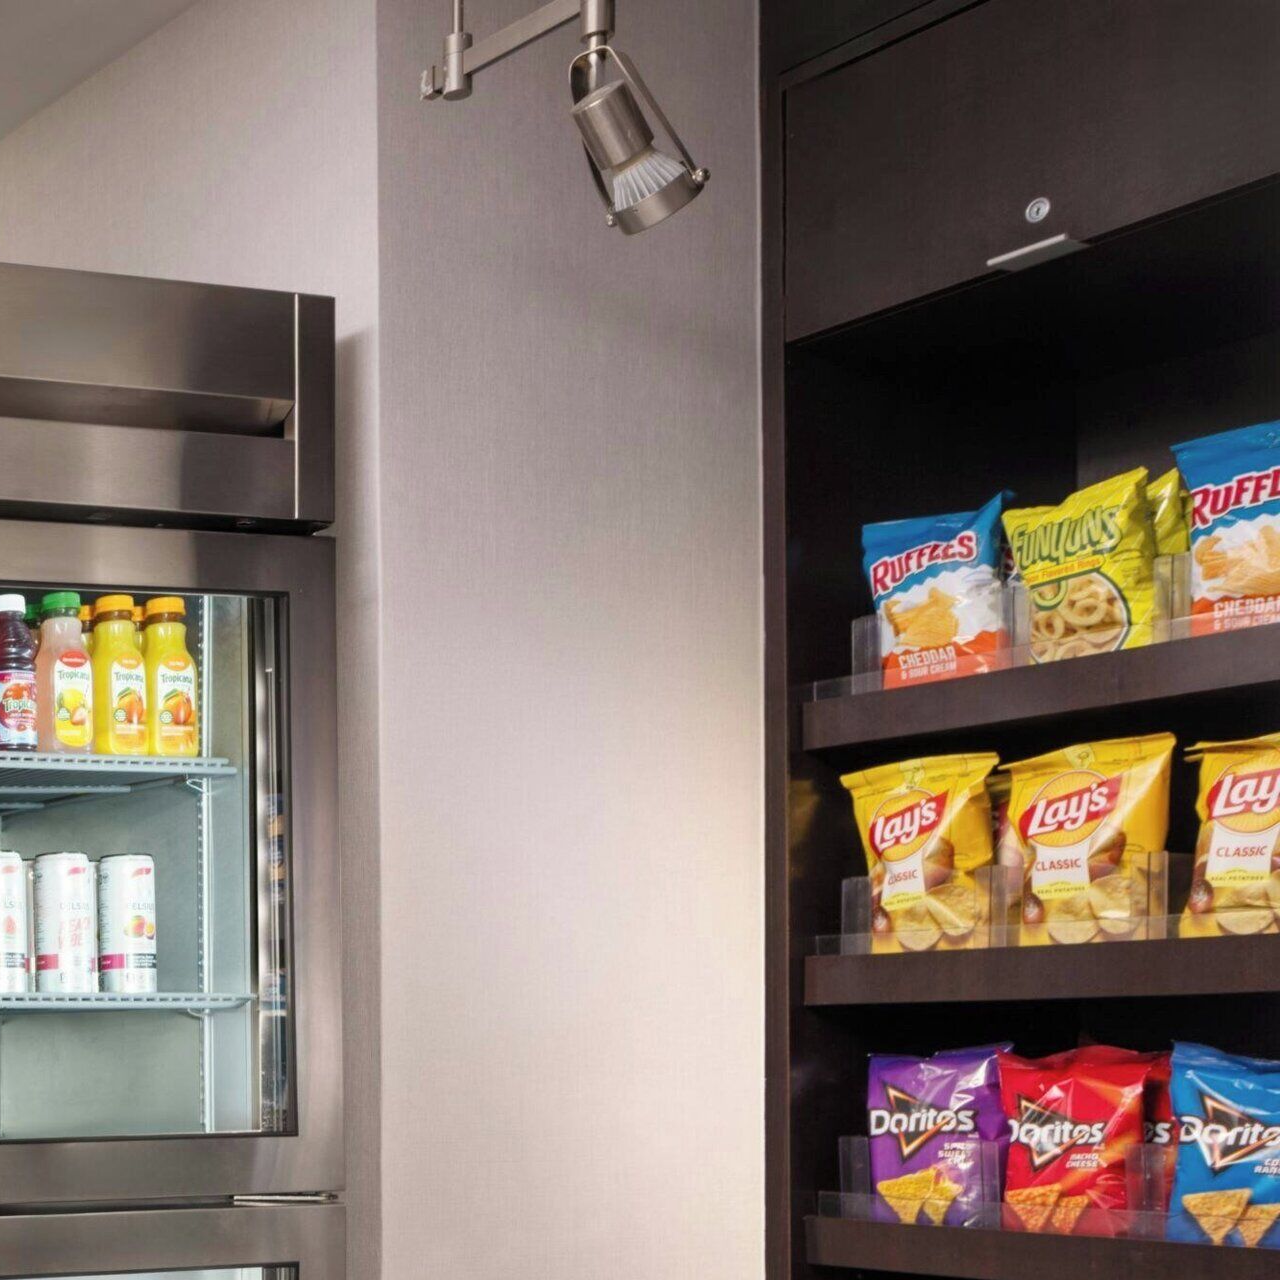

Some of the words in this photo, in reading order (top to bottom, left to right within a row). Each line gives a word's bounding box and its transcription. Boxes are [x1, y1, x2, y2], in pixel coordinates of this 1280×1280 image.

[1012, 504, 1123, 570] FUNYUNS
[871, 530, 978, 597] RUFFLES
[899, 646, 955, 670] CHEDDAR
[58, 670, 90, 682] Tropicana
[114, 671, 144, 683] Tropicana
[162, 673, 193, 685] Tropicana
[1027, 782, 1109, 837] Lay's
[874, 799, 938, 853] Lay's
[1216, 845, 1268, 858] CLASSIC
[1035, 858, 1082, 873] CLASSIC
[869, 1107, 975, 1138] Doritos
[1065, 1160, 1098, 1168] CHEESE
